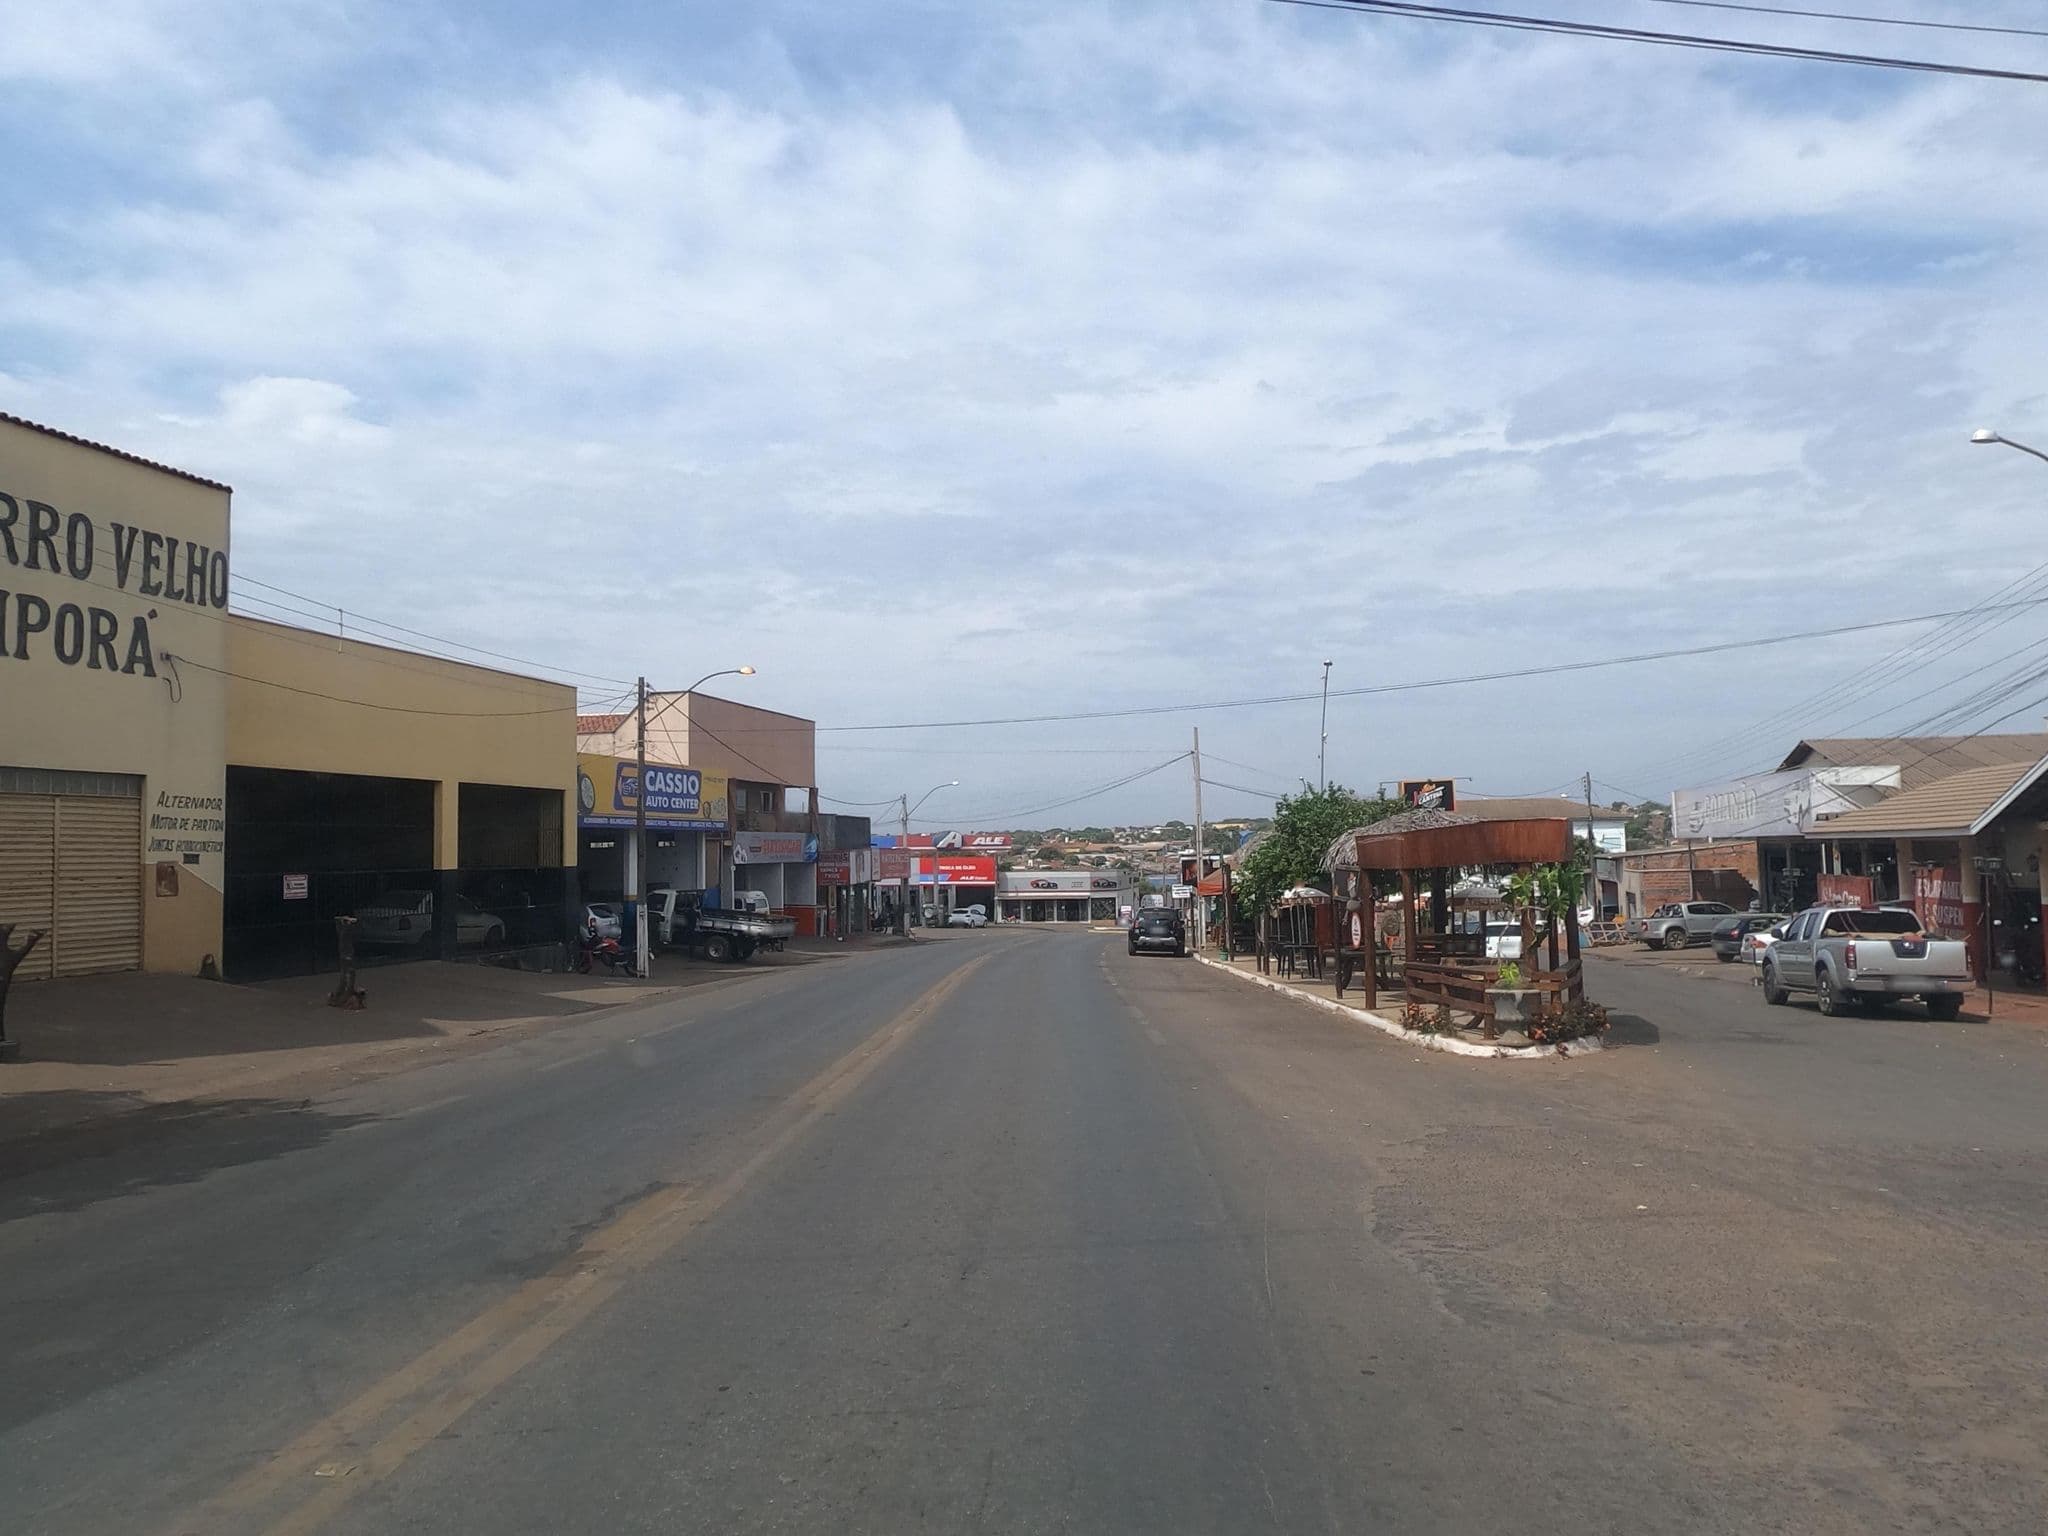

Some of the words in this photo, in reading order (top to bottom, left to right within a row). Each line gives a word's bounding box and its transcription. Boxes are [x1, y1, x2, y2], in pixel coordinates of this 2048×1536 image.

[110, 522, 228, 609] VELHO
[0, 589, 157, 677] IPORÁ
[645, 771, 699, 795] CASSIO
[157, 791, 223, 811] ALTERNADOR
[646, 796, 669, 808] AUTO
[671, 798, 699, 810] CENTER
[151, 814, 178, 831] MOTOR
[180, 818, 190, 831] DE
[192, 818, 224, 832] PARTIDA
[972, 836, 1004, 845] ALE
